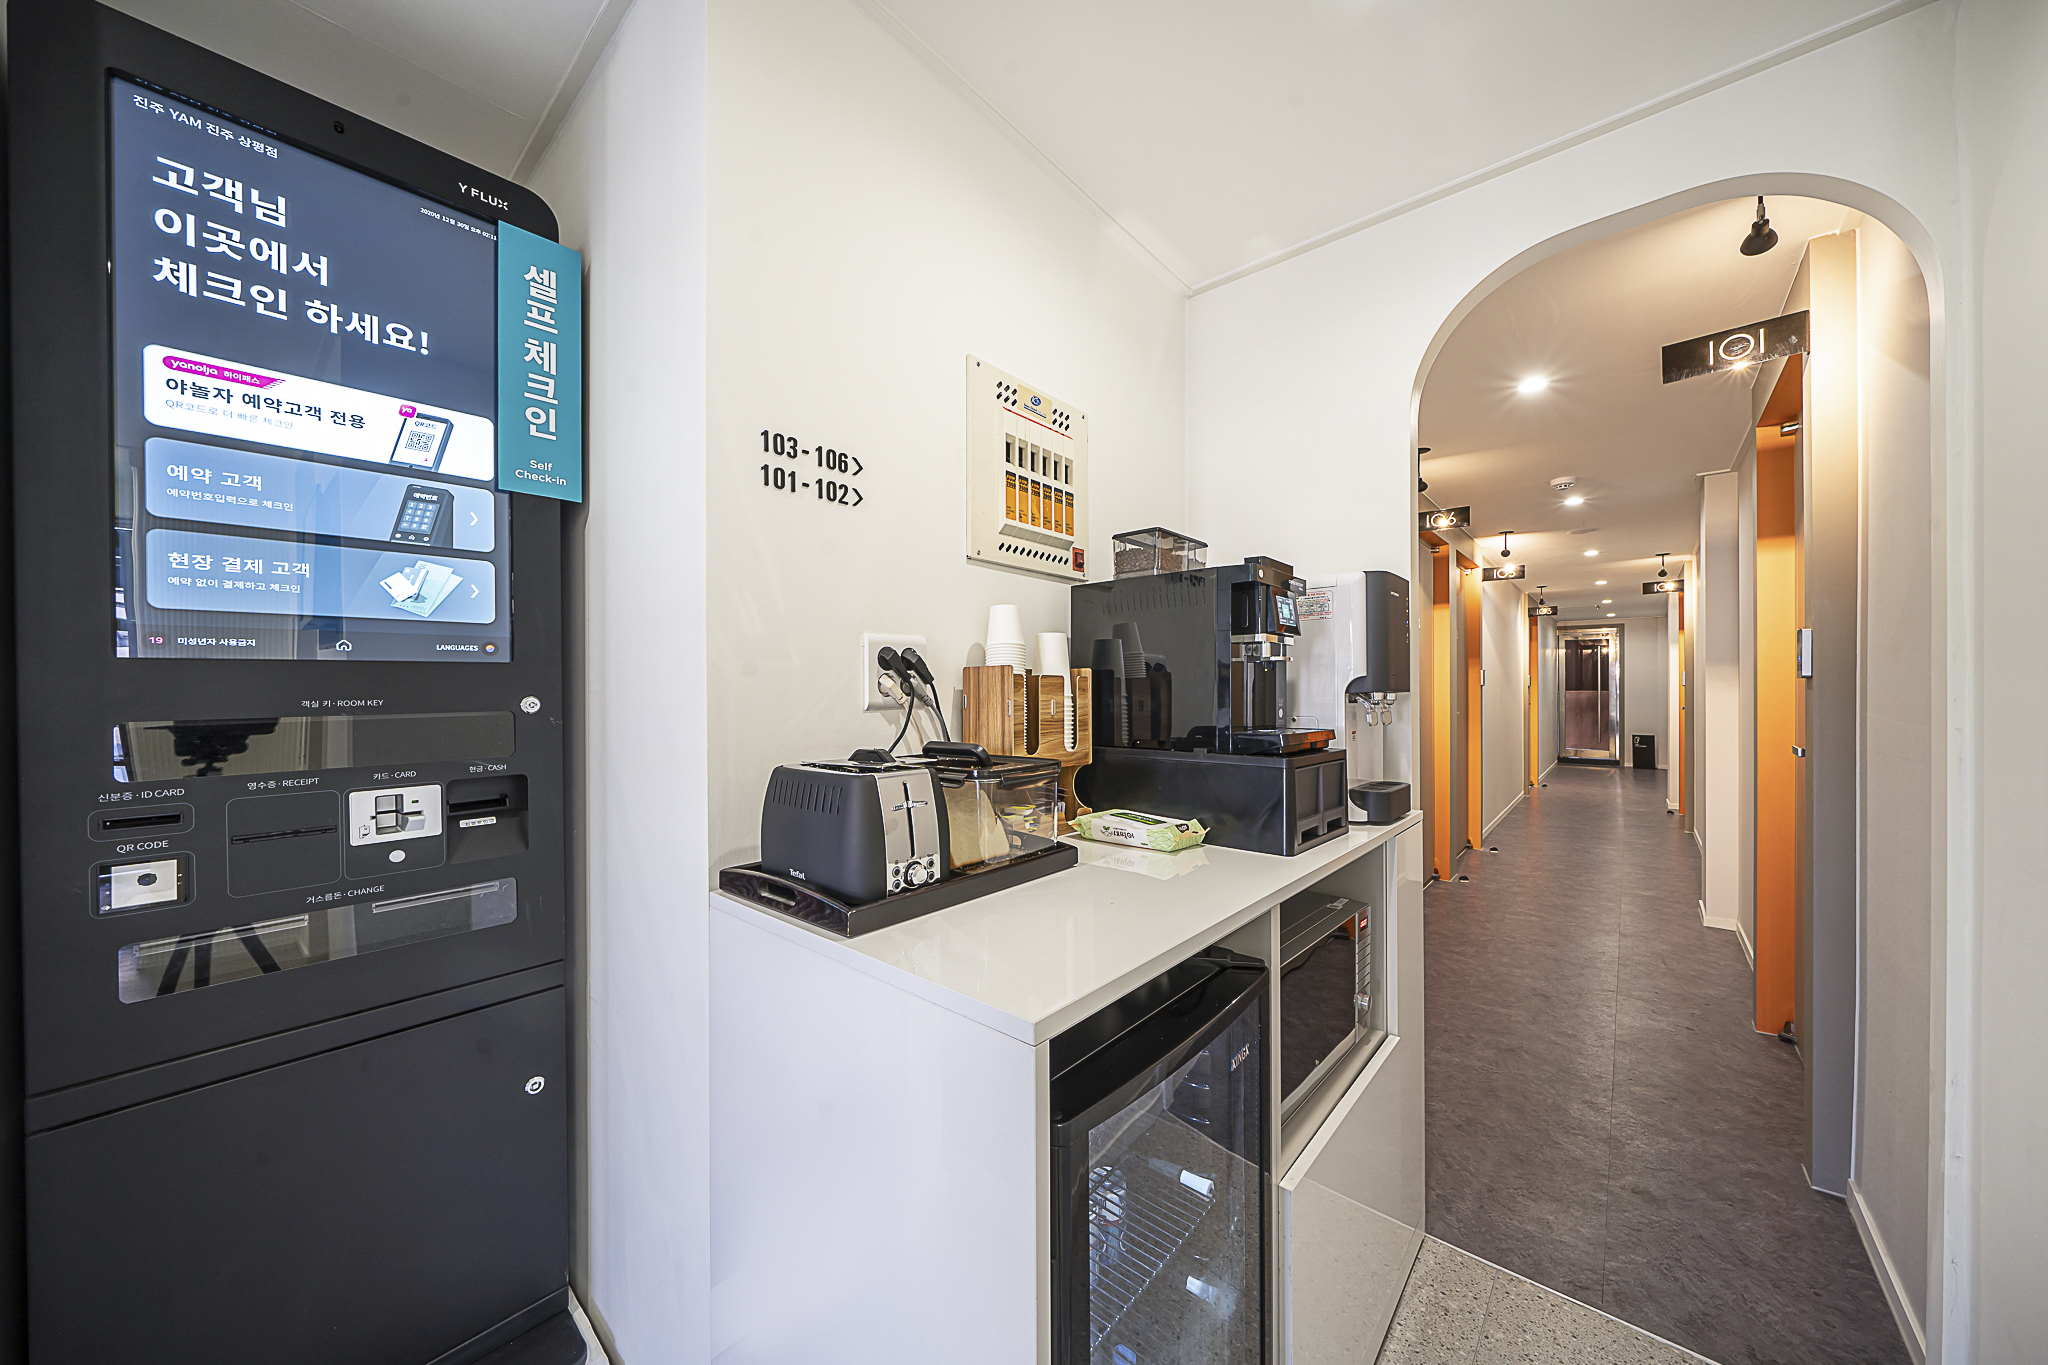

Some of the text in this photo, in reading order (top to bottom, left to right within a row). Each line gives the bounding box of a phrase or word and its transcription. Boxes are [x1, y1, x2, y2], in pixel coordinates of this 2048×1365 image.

[133, 94, 278, 158] 진주 YAM 진주 상평점
[152, 156, 287, 228] 고객님
[458, 182, 508, 211] Y FLUX
[153, 208, 328, 287] 이곳에서
[152, 256, 429, 356] 체크인 하세요!
[523, 265, 559, 441] 셀프 체크인
[1709, 327, 1765, 366] 101
[170, 359, 261, 385] yanolja 하이패스
[165, 378, 366, 429] 야놀자 예약고객 전용
[165, 399, 294, 430] QR코드로 더 빠른 체크인
[529, 459, 553, 472] Self
[166, 464, 262, 492] 예약 고객
[515, 469, 567, 486] Check-in
[166, 488, 294, 512] 예약번호입력으로 체크인
[1426, 511, 1457, 529] 106
[168, 552, 310, 578] 현장 결제 고객
[168, 576, 301, 594] 예약 없이 결제하고 체크인
[1653, 582, 1675, 592] 10
[149, 636, 256, 647] 19 미성년자 사용금지
[436, 644, 479, 652] LANGUAGES
[301, 700, 319, 708] 객실
[373, 771, 417, 780] 카드 CARD
[487, 764, 507, 772] CASH
[247, 777, 320, 790] 영수증 RECEIPT
[98, 788, 185, 803] 신분증 ID CARD
[116, 840, 169, 853] QR CODE
[789, 868, 806, 880] Tefal
[306, 885, 385, 903] 거스름돈 CHANGE
